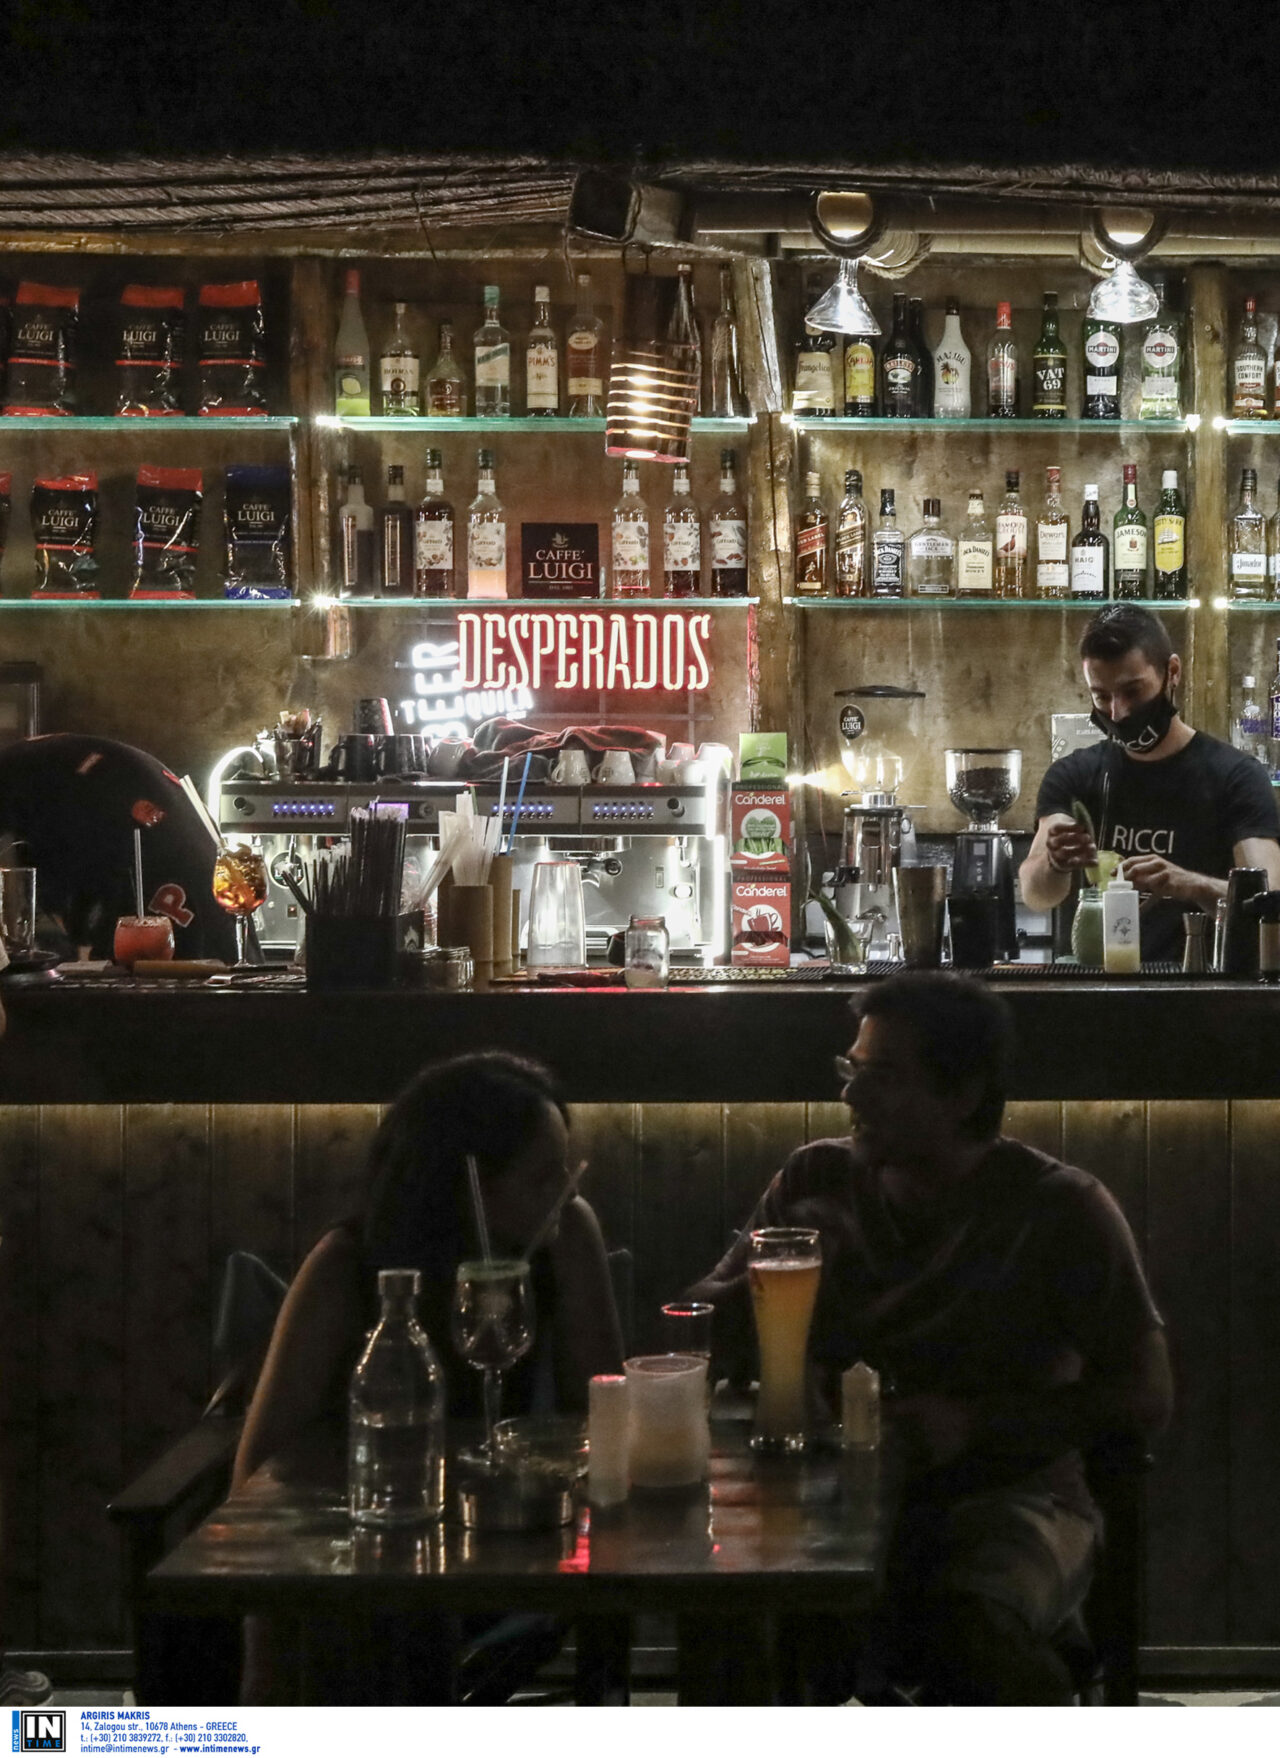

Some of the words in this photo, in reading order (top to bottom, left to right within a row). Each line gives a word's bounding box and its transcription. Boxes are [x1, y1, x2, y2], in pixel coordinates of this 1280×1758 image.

[17, 329, 54, 342] LUIGI
[122, 329, 157, 342] LUIGI
[203, 330, 240, 341] LUIGI
[1088, 346, 1117, 354] MARTINI
[1146, 346, 1175, 354] MARTINI
[528, 356, 556, 368] PIMM'S
[1036, 367, 1065, 381] VAT
[1237, 364, 1264, 373] SOUTHERN
[1042, 379, 1062, 391] 69
[41, 516, 80, 528] LUIGI
[142, 511, 181, 526] LUIGI
[237, 510, 275, 522] LUIGI
[1074, 556, 1094, 564] HAIG
[528, 562, 593, 579] LUIGI
[457, 613, 711, 691] DESPERADOS
[842, 722, 861, 731] LUIGI
[735, 792, 785, 807] Canderel
[1112, 825, 1175, 854] RICCI
[735, 883, 787, 897] Canderel
